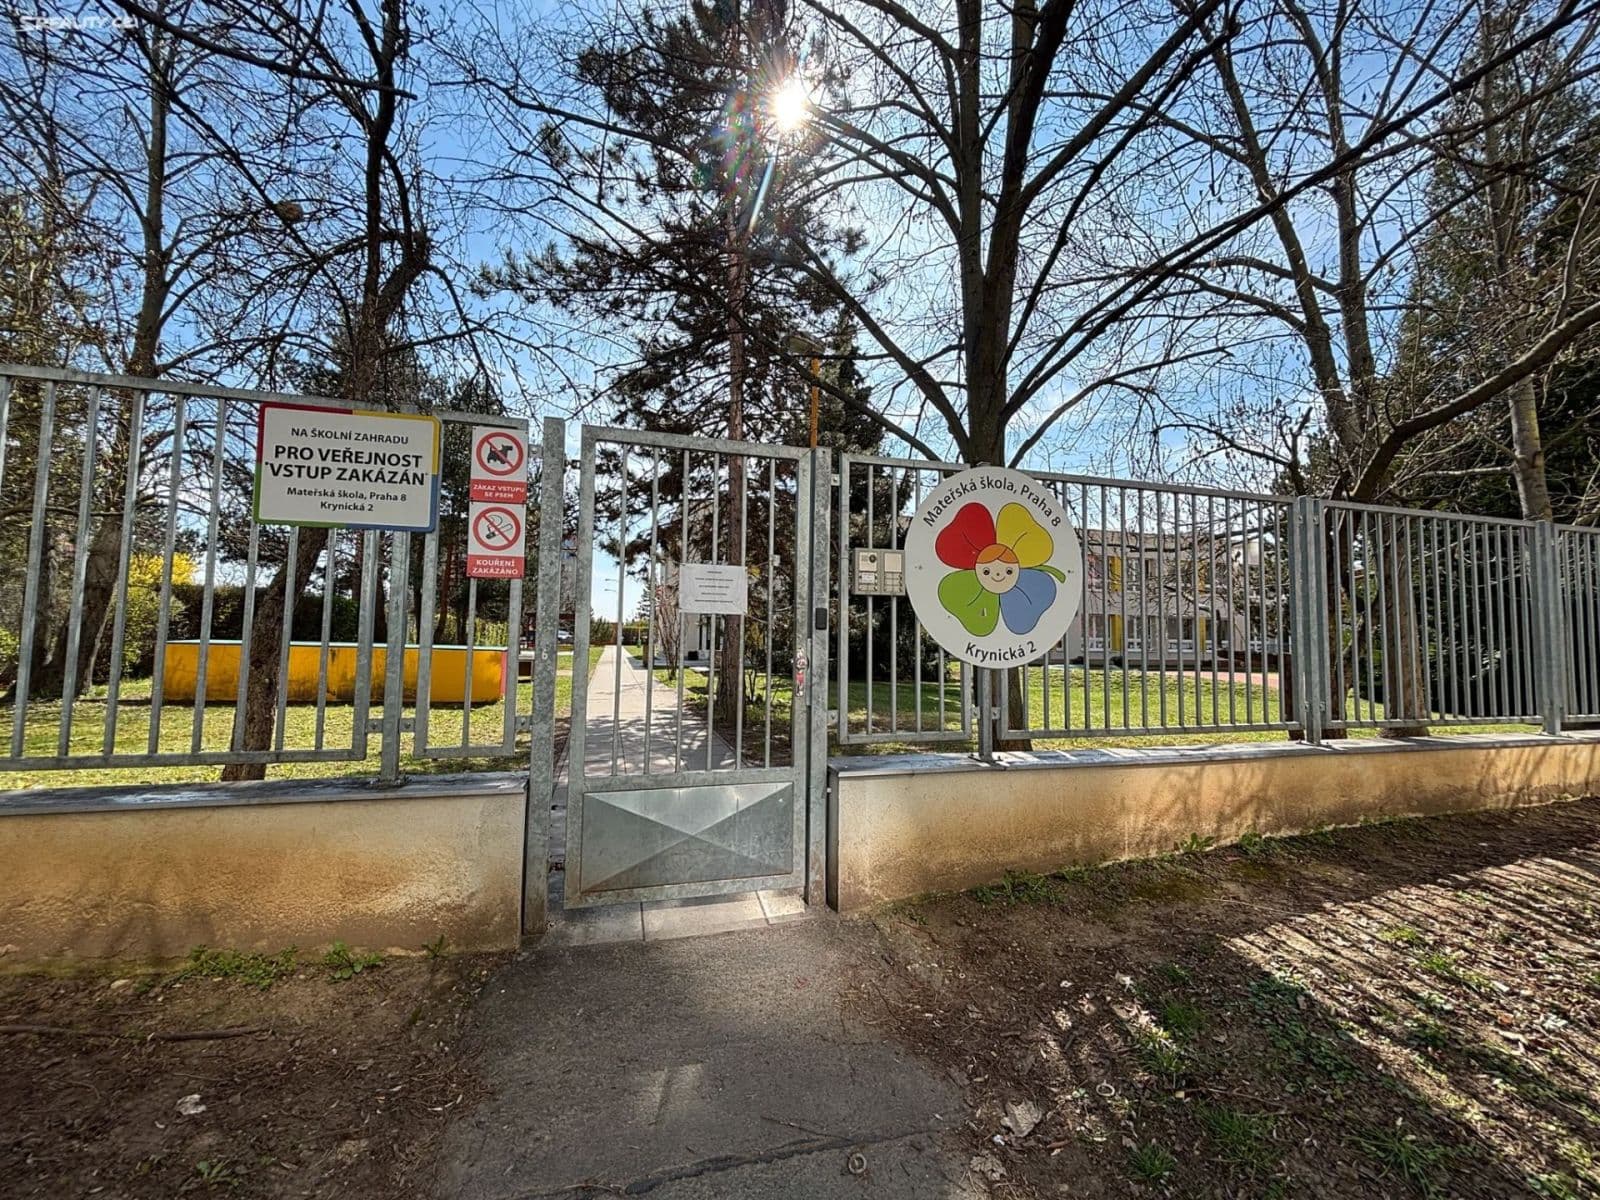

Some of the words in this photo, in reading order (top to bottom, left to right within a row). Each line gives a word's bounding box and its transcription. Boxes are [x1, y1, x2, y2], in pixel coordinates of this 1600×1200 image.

[291, 427, 308, 438] NA
[311, 427, 352, 441] ŠKOLNÍ
[354, 432, 409, 445] ZAHRADU
[274, 444, 314, 461] PRO
[318, 446, 423, 469] VEŘEJNOST
[269, 462, 332, 480] VSTUP
[335, 467, 425, 486] ZAKÁZÁN
[287, 486, 335, 498] Mateřská
[337, 489, 367, 501] škola,
[369, 491, 398, 502] Praha
[400, 493, 407, 502] 8
[923, 478, 977, 527] Mateřská
[980, 475, 1017, 495] škola,
[1020, 484, 1053, 517] Praha
[1051, 516, 1062, 527] 8
[320, 500, 365, 512] Krynická
[367, 503, 374, 512] 2
[472, 566, 518, 576] ZAKÁZÁNO
[476, 557, 515, 567] KOUŘENÍ
[966, 642, 1025, 662] Krynická
[1026, 640, 1037, 654] 2
